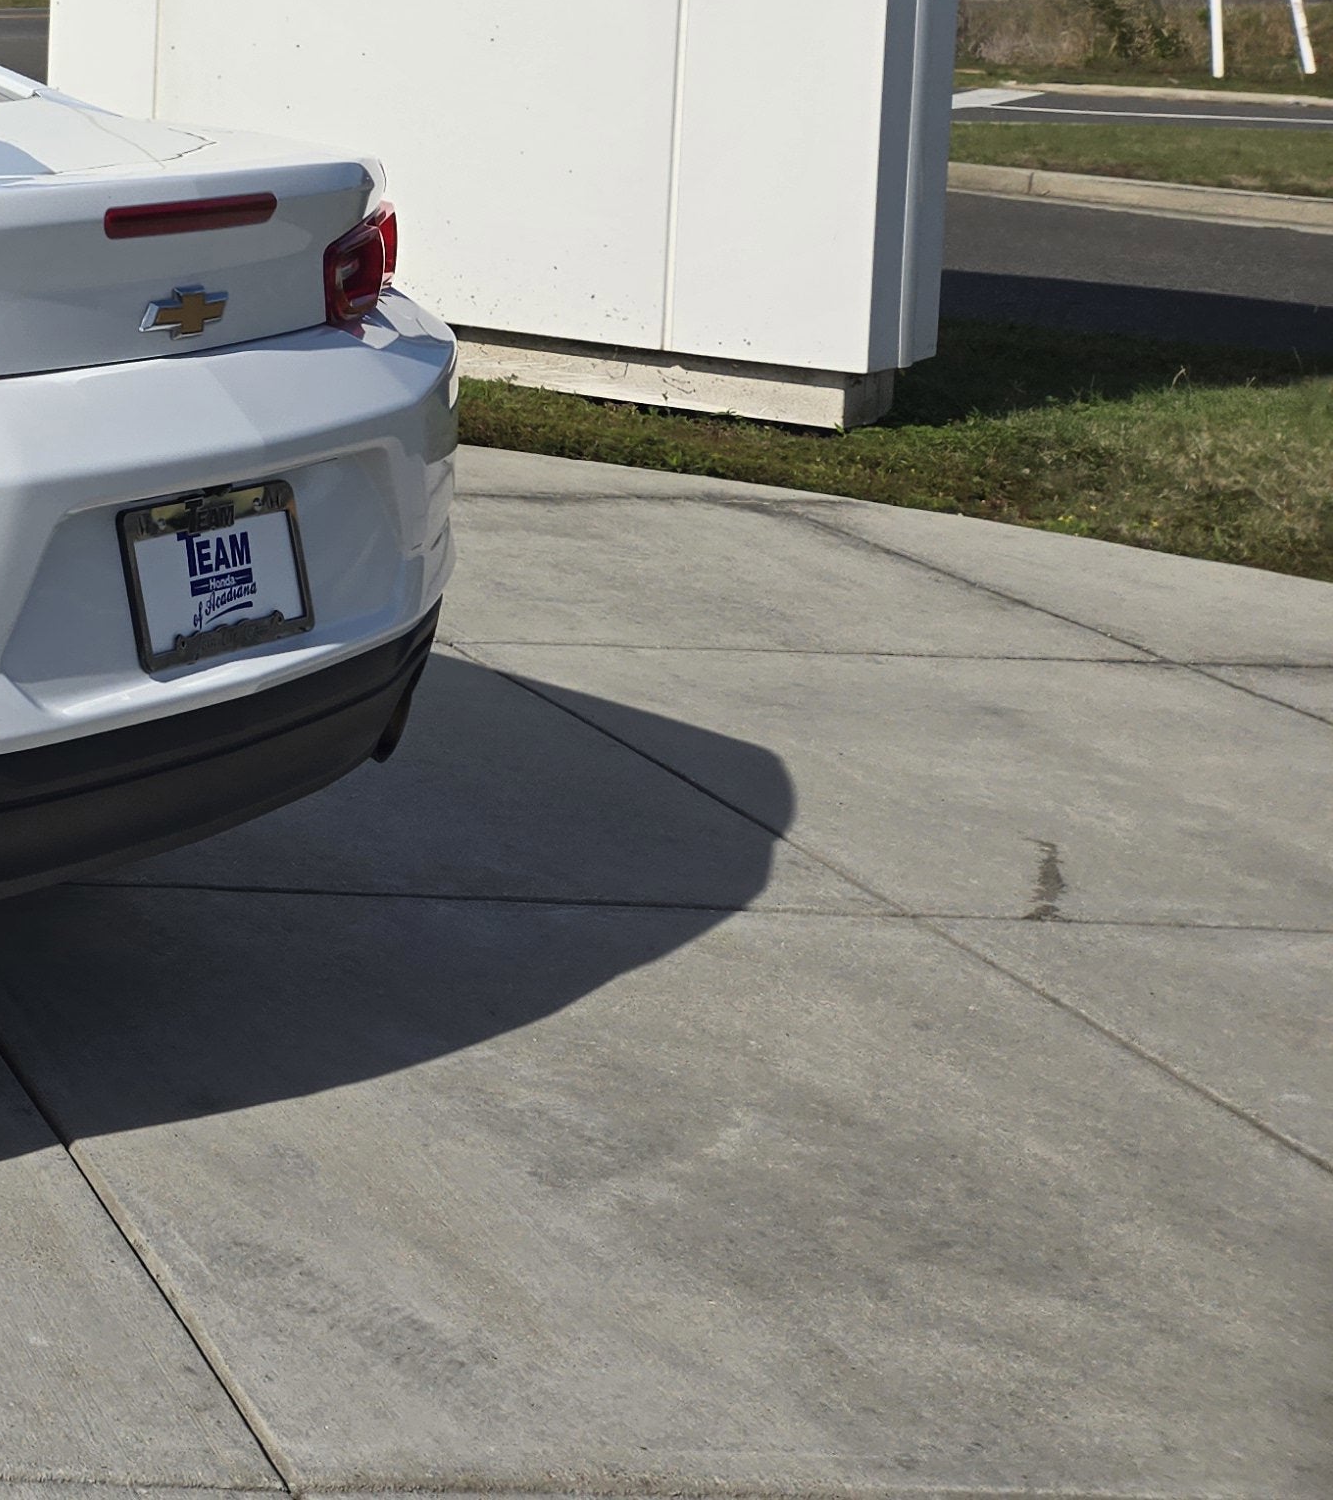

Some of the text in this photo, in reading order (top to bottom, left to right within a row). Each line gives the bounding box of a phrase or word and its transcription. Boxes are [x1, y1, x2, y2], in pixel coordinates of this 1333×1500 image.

[176, 531, 251, 577] TEAM
[209, 574, 237, 590] Honda
[193, 582, 257, 630] of Acadiana
